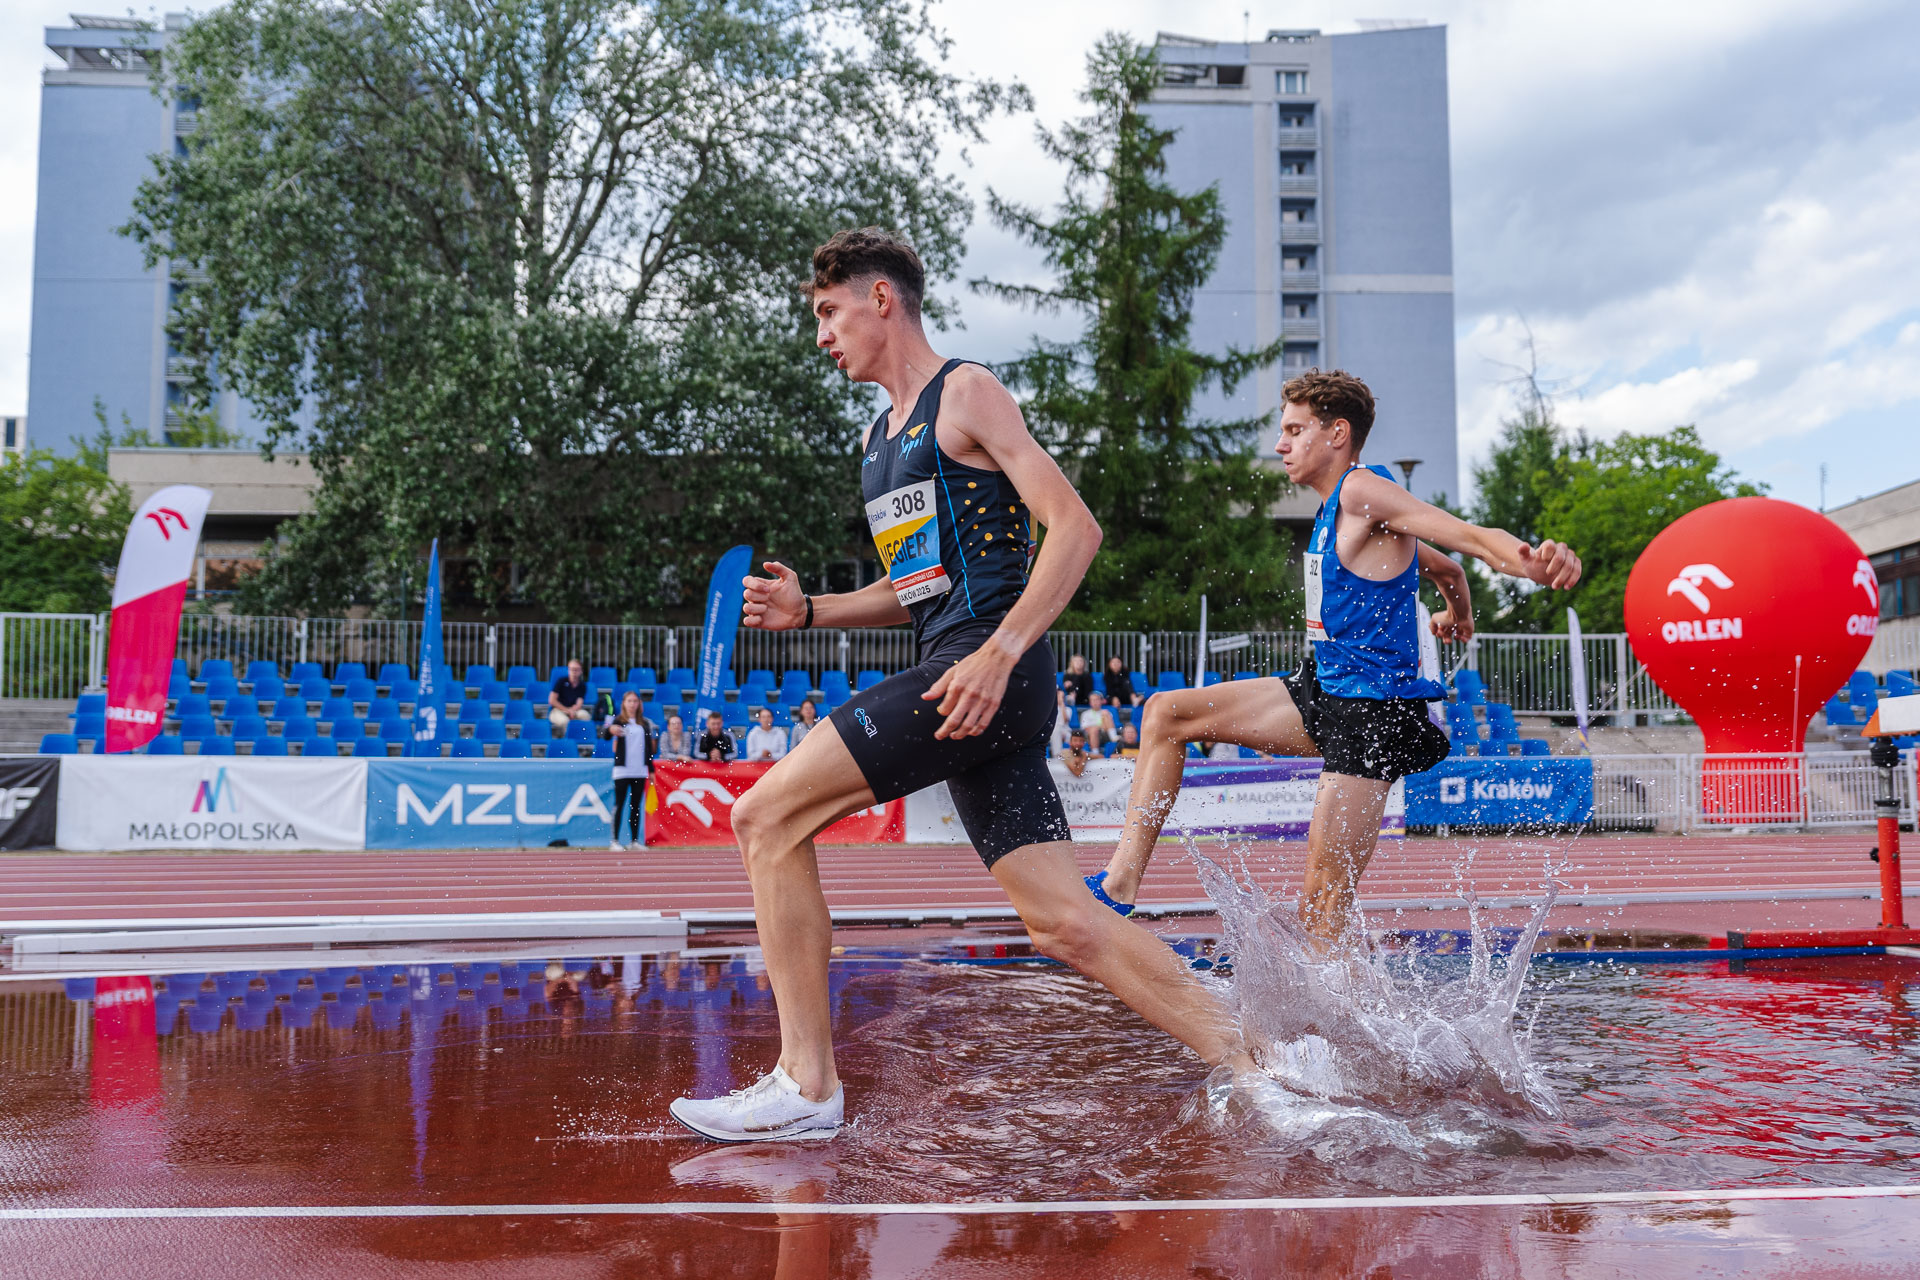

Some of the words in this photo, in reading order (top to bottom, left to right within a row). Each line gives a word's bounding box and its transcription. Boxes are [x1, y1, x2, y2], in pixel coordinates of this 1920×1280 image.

[891, 490, 925, 519] 308
[1661, 617, 1743, 643] ORLEN
[1057, 782, 1094, 793] stwo
[1473, 777, 1554, 801] Kraków
[396, 783, 613, 825] MZLA
[128, 821, 299, 841] MAŁOPOLSKA
